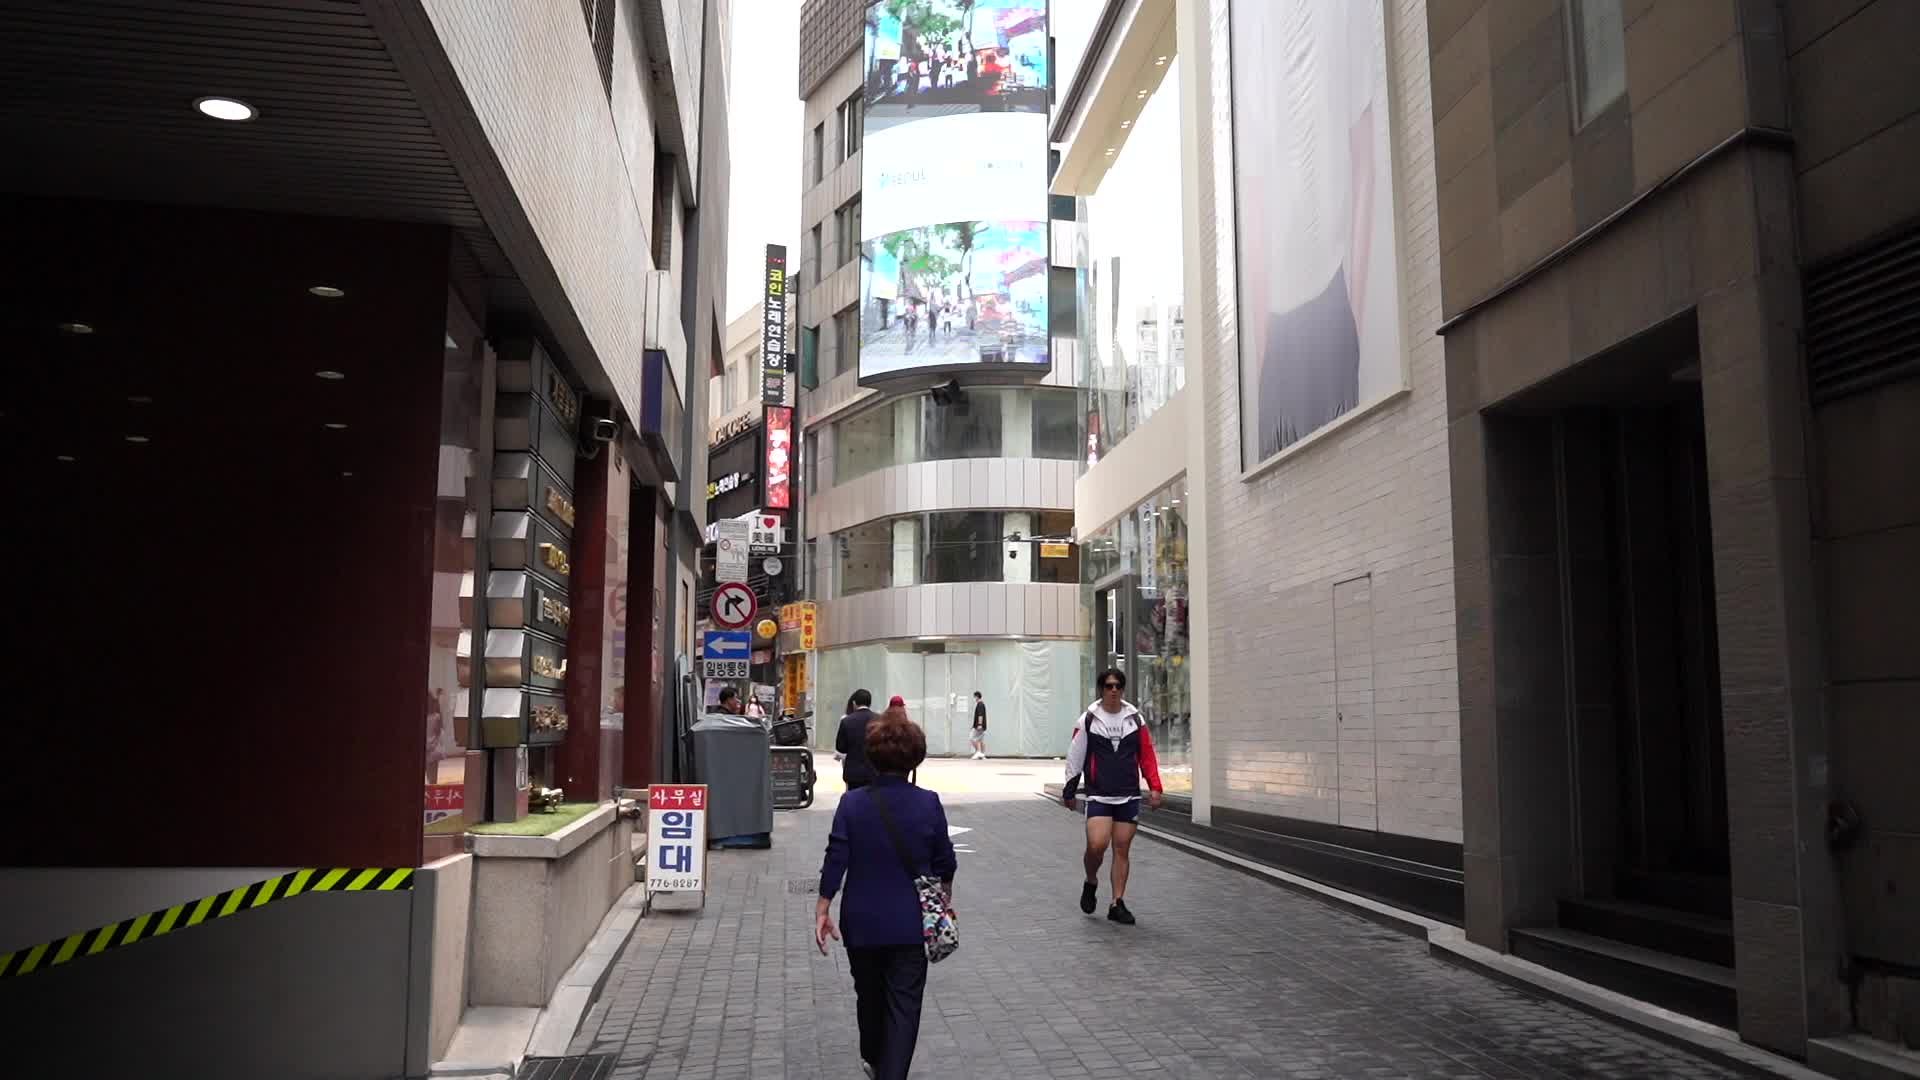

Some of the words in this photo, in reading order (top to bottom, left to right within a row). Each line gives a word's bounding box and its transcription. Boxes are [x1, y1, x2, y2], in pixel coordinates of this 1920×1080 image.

[754, 516, 760, 529] I
[803, 614, 814, 648] 부동산
[705, 661, 747, 677] 일방통행
[652, 789, 702, 807] 사무실
[659, 811, 692, 873] 임대
